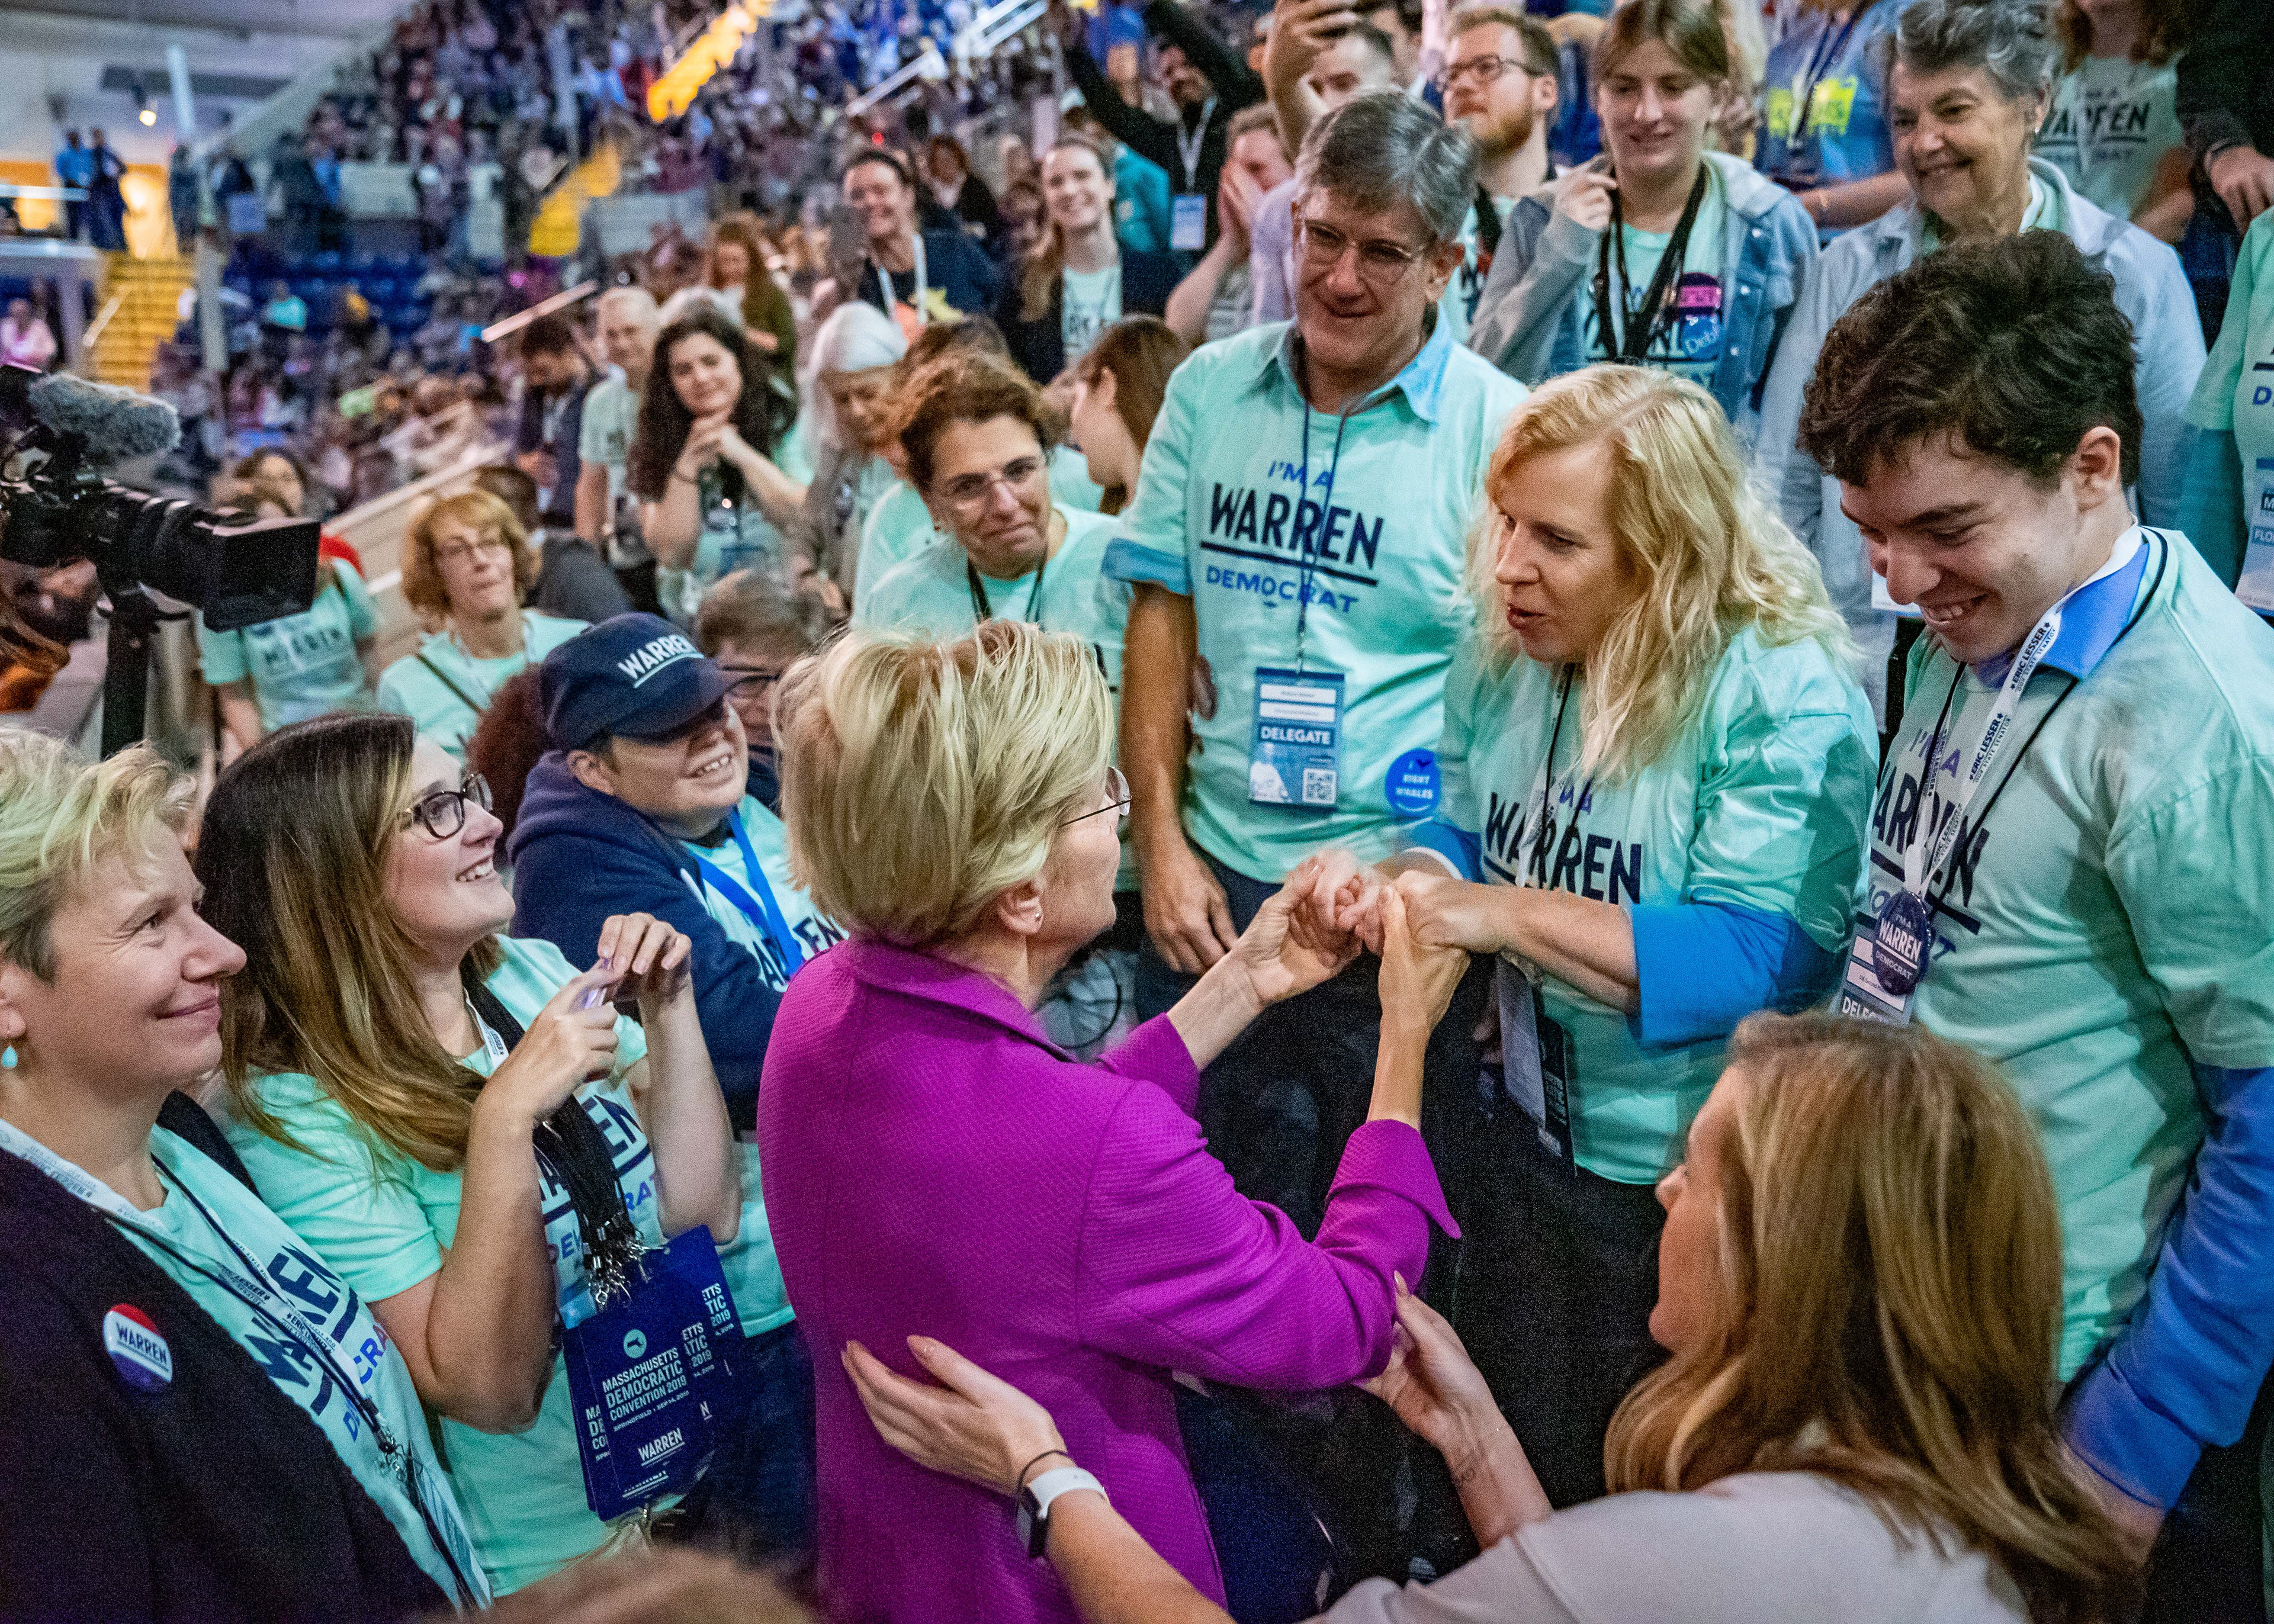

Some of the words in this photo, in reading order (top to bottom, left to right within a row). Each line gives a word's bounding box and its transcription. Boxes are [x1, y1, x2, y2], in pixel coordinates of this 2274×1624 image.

[1268, 461, 1308, 486] I'M
[1313, 471, 1334, 488] A
[1210, 483, 1385, 570] WARREN
[1207, 565, 1358, 613] DEMOCRAT
[2012, 661, 2027, 684] ERIC
[2022, 627, 2047, 662] LESSER
[1261, 726, 1331, 745] DELEGATE
[1971, 754, 1985, 776] ERIC
[1981, 719, 2001, 754] LESSER
[1939, 748, 1961, 778] A
[1878, 919, 1923, 962] WARREN
[1875, 950, 1913, 979] DEMOCRAT
[711, 1308, 731, 1327] 2019
[115, 1315, 168, 1365] WARREN
[690, 1349, 712, 1368] 2019
[602, 1347, 680, 1393] MASSACHUSETTS
[606, 1359, 683, 1409] DEMOCRATIC
[610, 1385, 667, 1422] CONVENTION
[666, 1375, 688, 1394] 2019
[613, 1408, 653, 1433] SPRINGFIELD
[637, 1427, 683, 1461] WARREN
